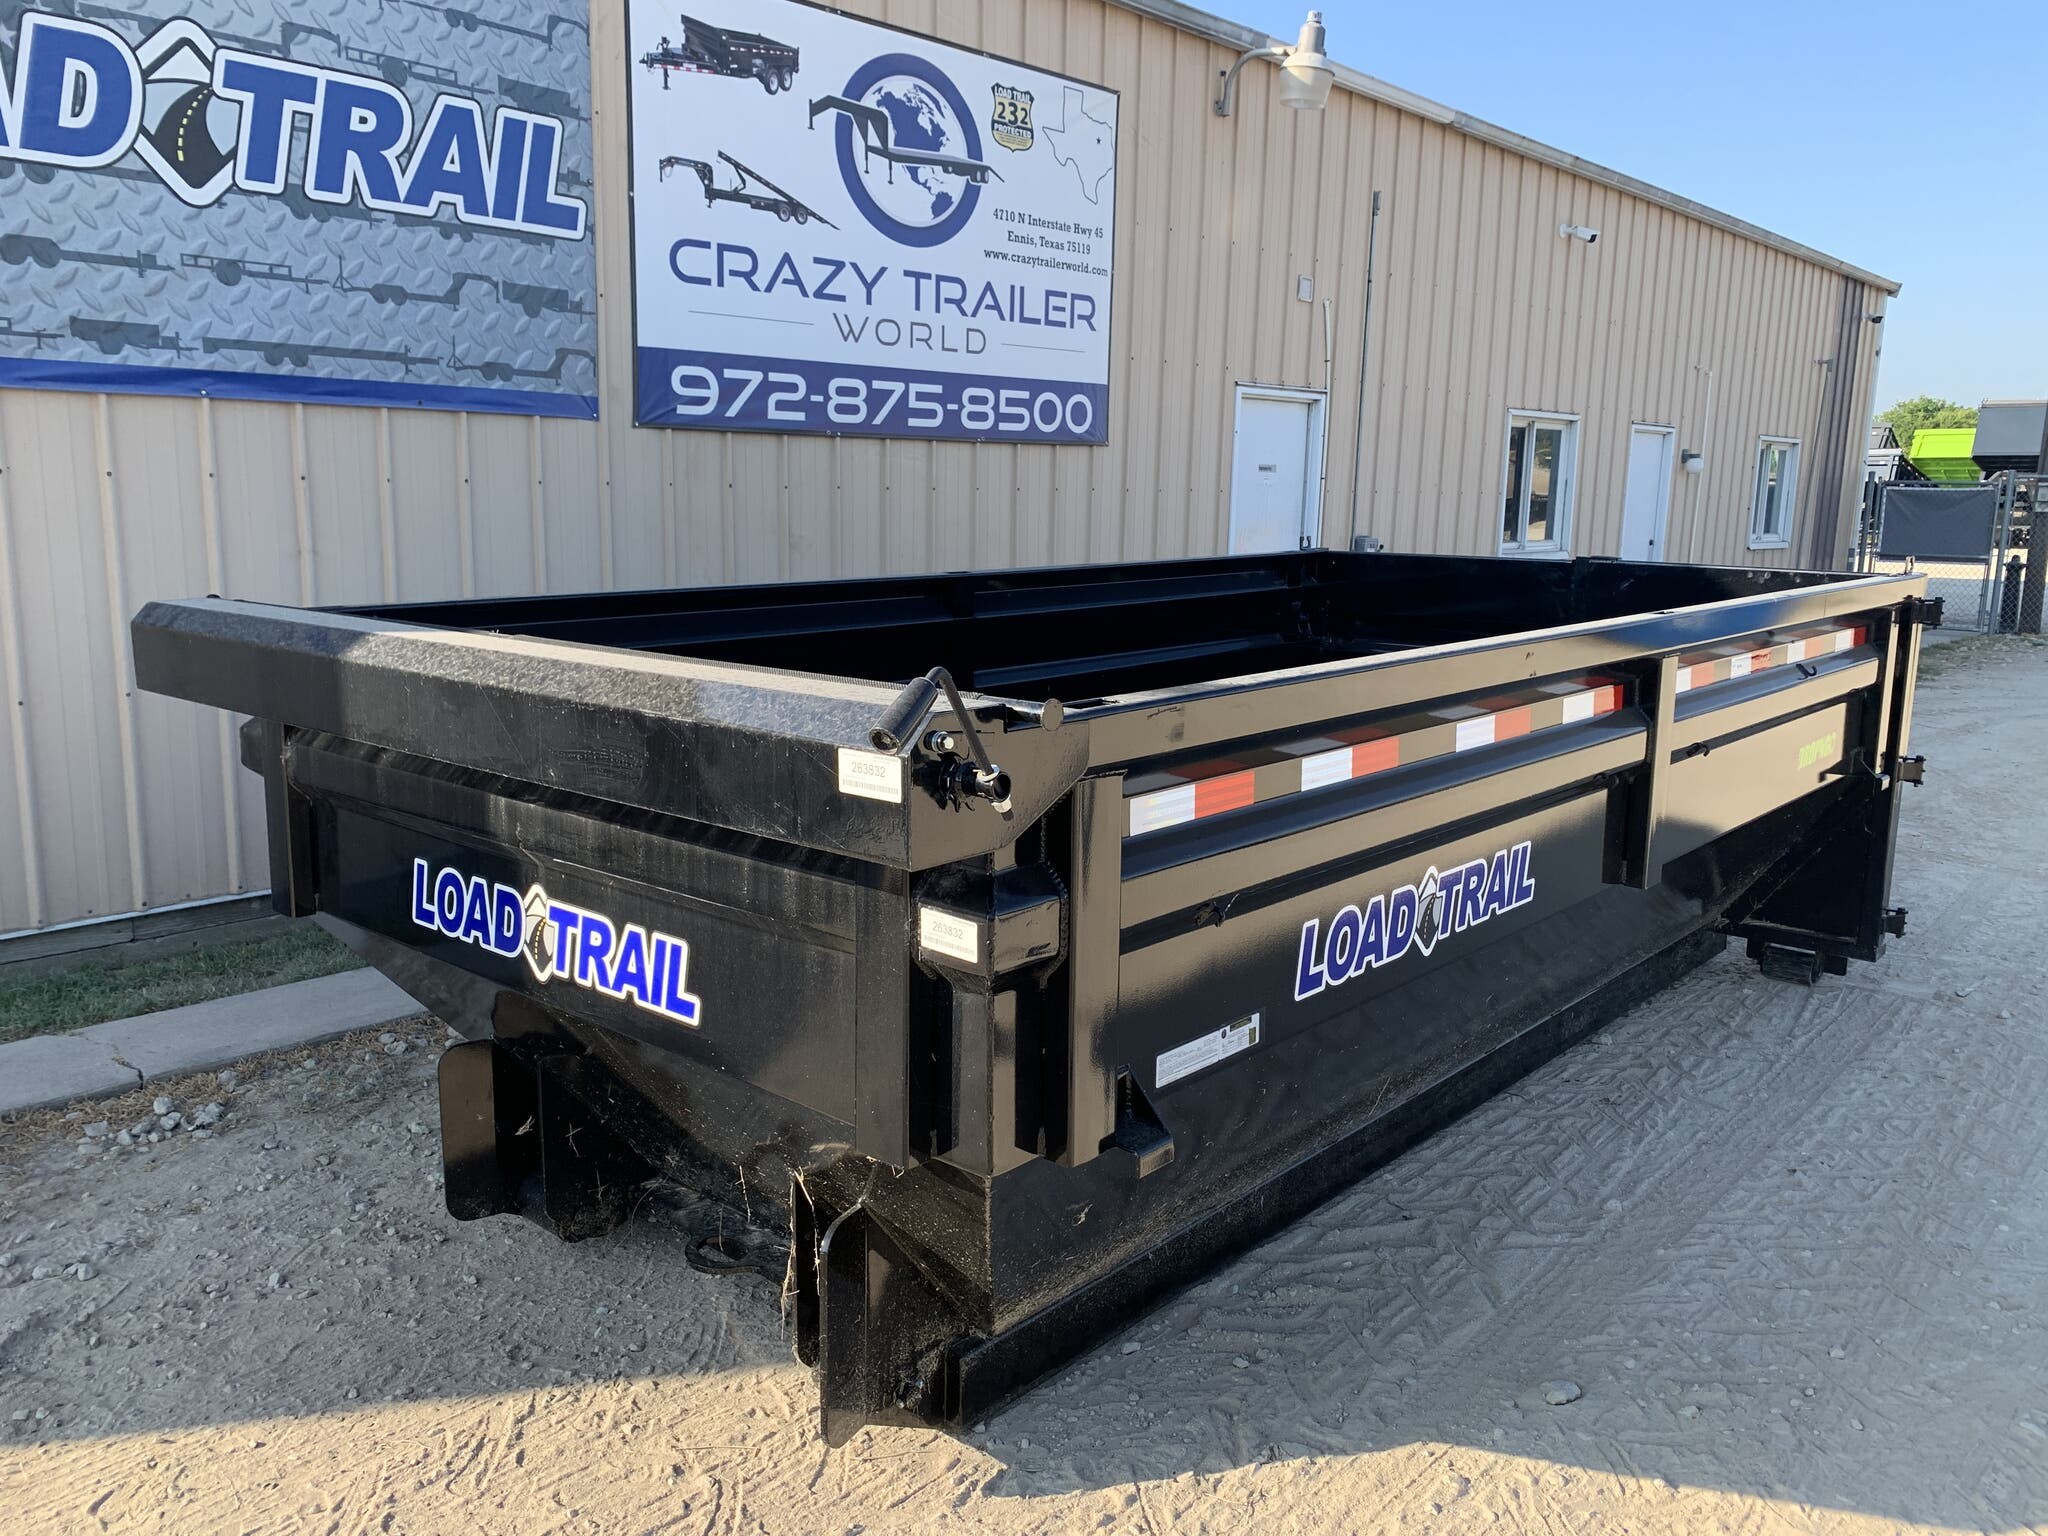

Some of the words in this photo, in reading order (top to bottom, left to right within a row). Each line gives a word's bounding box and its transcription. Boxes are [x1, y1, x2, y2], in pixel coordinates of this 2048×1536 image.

[994, 85, 1012, 99] LOAD
[1013, 91, 1030, 104] TRAIL
[997, 101, 1029, 126] 232
[212, 49, 588, 240] TRAIL
[993, 123, 1032, 138] PROTECTED
[993, 208, 1016, 222] 4710
[1018, 212, 1026, 224] N
[1028, 214, 1072, 233] Interstate
[1073, 222, 1093, 239] Hwy
[1094, 226, 1104, 239] 45
[1007, 230, 1038, 248] Ennis,
[1039, 236, 1065, 251] Texas
[1066, 240, 1091, 255] 75119
[983, 249, 1108, 277] www.crazytrailerworld.com
[669, 238, 888, 305] CRAZY
[903, 269, 1097, 332] TRAILER
[832, 312, 987, 355] WORLD
[671, 365, 1093, 434] 972-875-8500
[851, 761, 886, 778] 263832
[932, 920, 964, 939] 263832
[1295, 884, 1419, 1001] LOAD
[1437, 841, 1535, 940] TRAIL
[412, 857, 525, 957] LOAD
[546, 898, 700, 1026] TRAIL
